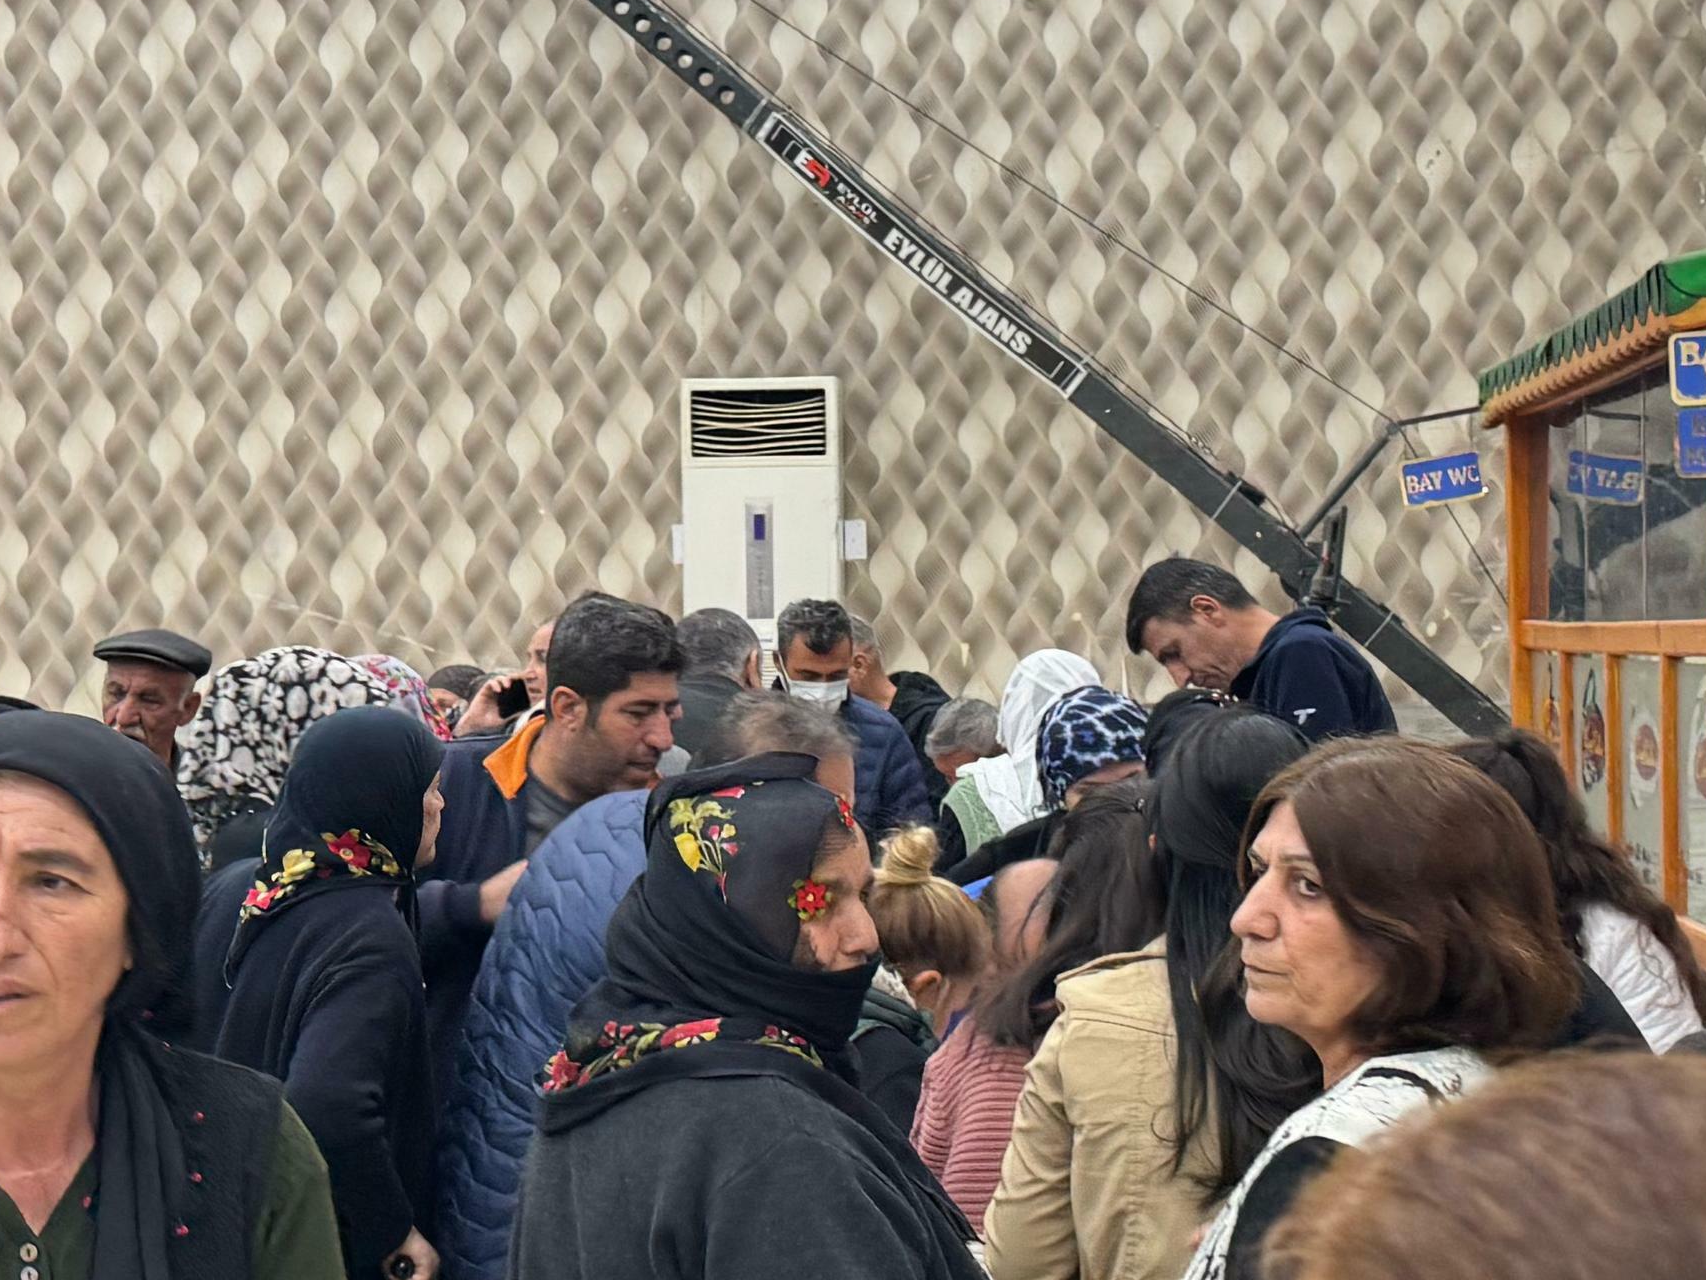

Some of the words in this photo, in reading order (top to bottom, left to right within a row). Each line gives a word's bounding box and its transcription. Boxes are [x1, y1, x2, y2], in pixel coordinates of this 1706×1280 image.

[881, 227, 951, 295] EYLÜL
[950, 286, 1033, 355] AJANS
[1405, 469, 1443, 495] BAY
[1447, 464, 1481, 486] WC
